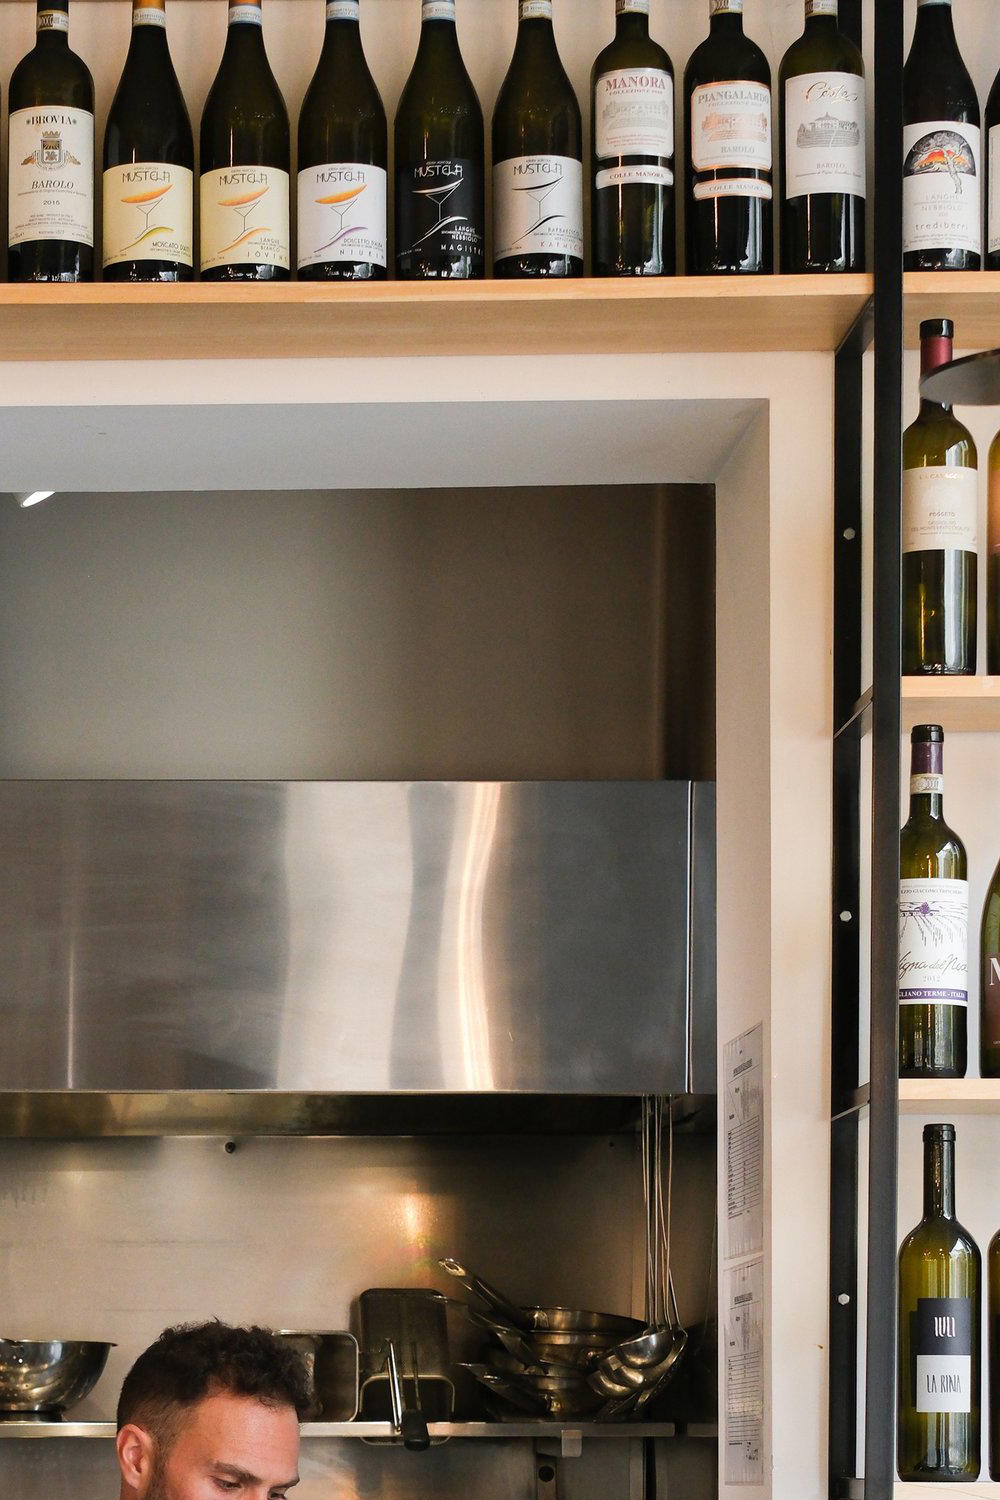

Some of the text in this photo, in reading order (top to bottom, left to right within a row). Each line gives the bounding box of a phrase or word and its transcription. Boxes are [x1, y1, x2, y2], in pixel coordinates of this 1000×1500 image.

[605, 75, 666, 92] MANORA
[31, 114, 72, 126] BROVIA
[721, 144, 755, 154] BAROLO
[414, 164, 463, 178] MUSTELA
[513, 163, 563, 176] MUSTELA
[609, 172, 632, 180] COLLE
[122, 170, 171, 183] MUSTELA
[219, 173, 268, 186] MUSTELA
[316, 170, 365, 184] MUSTELA
[31, 180, 74, 190] BAROLO
[923, 989, 947, 998] TERME
[926, 1374, 962, 1394] LA RINA
